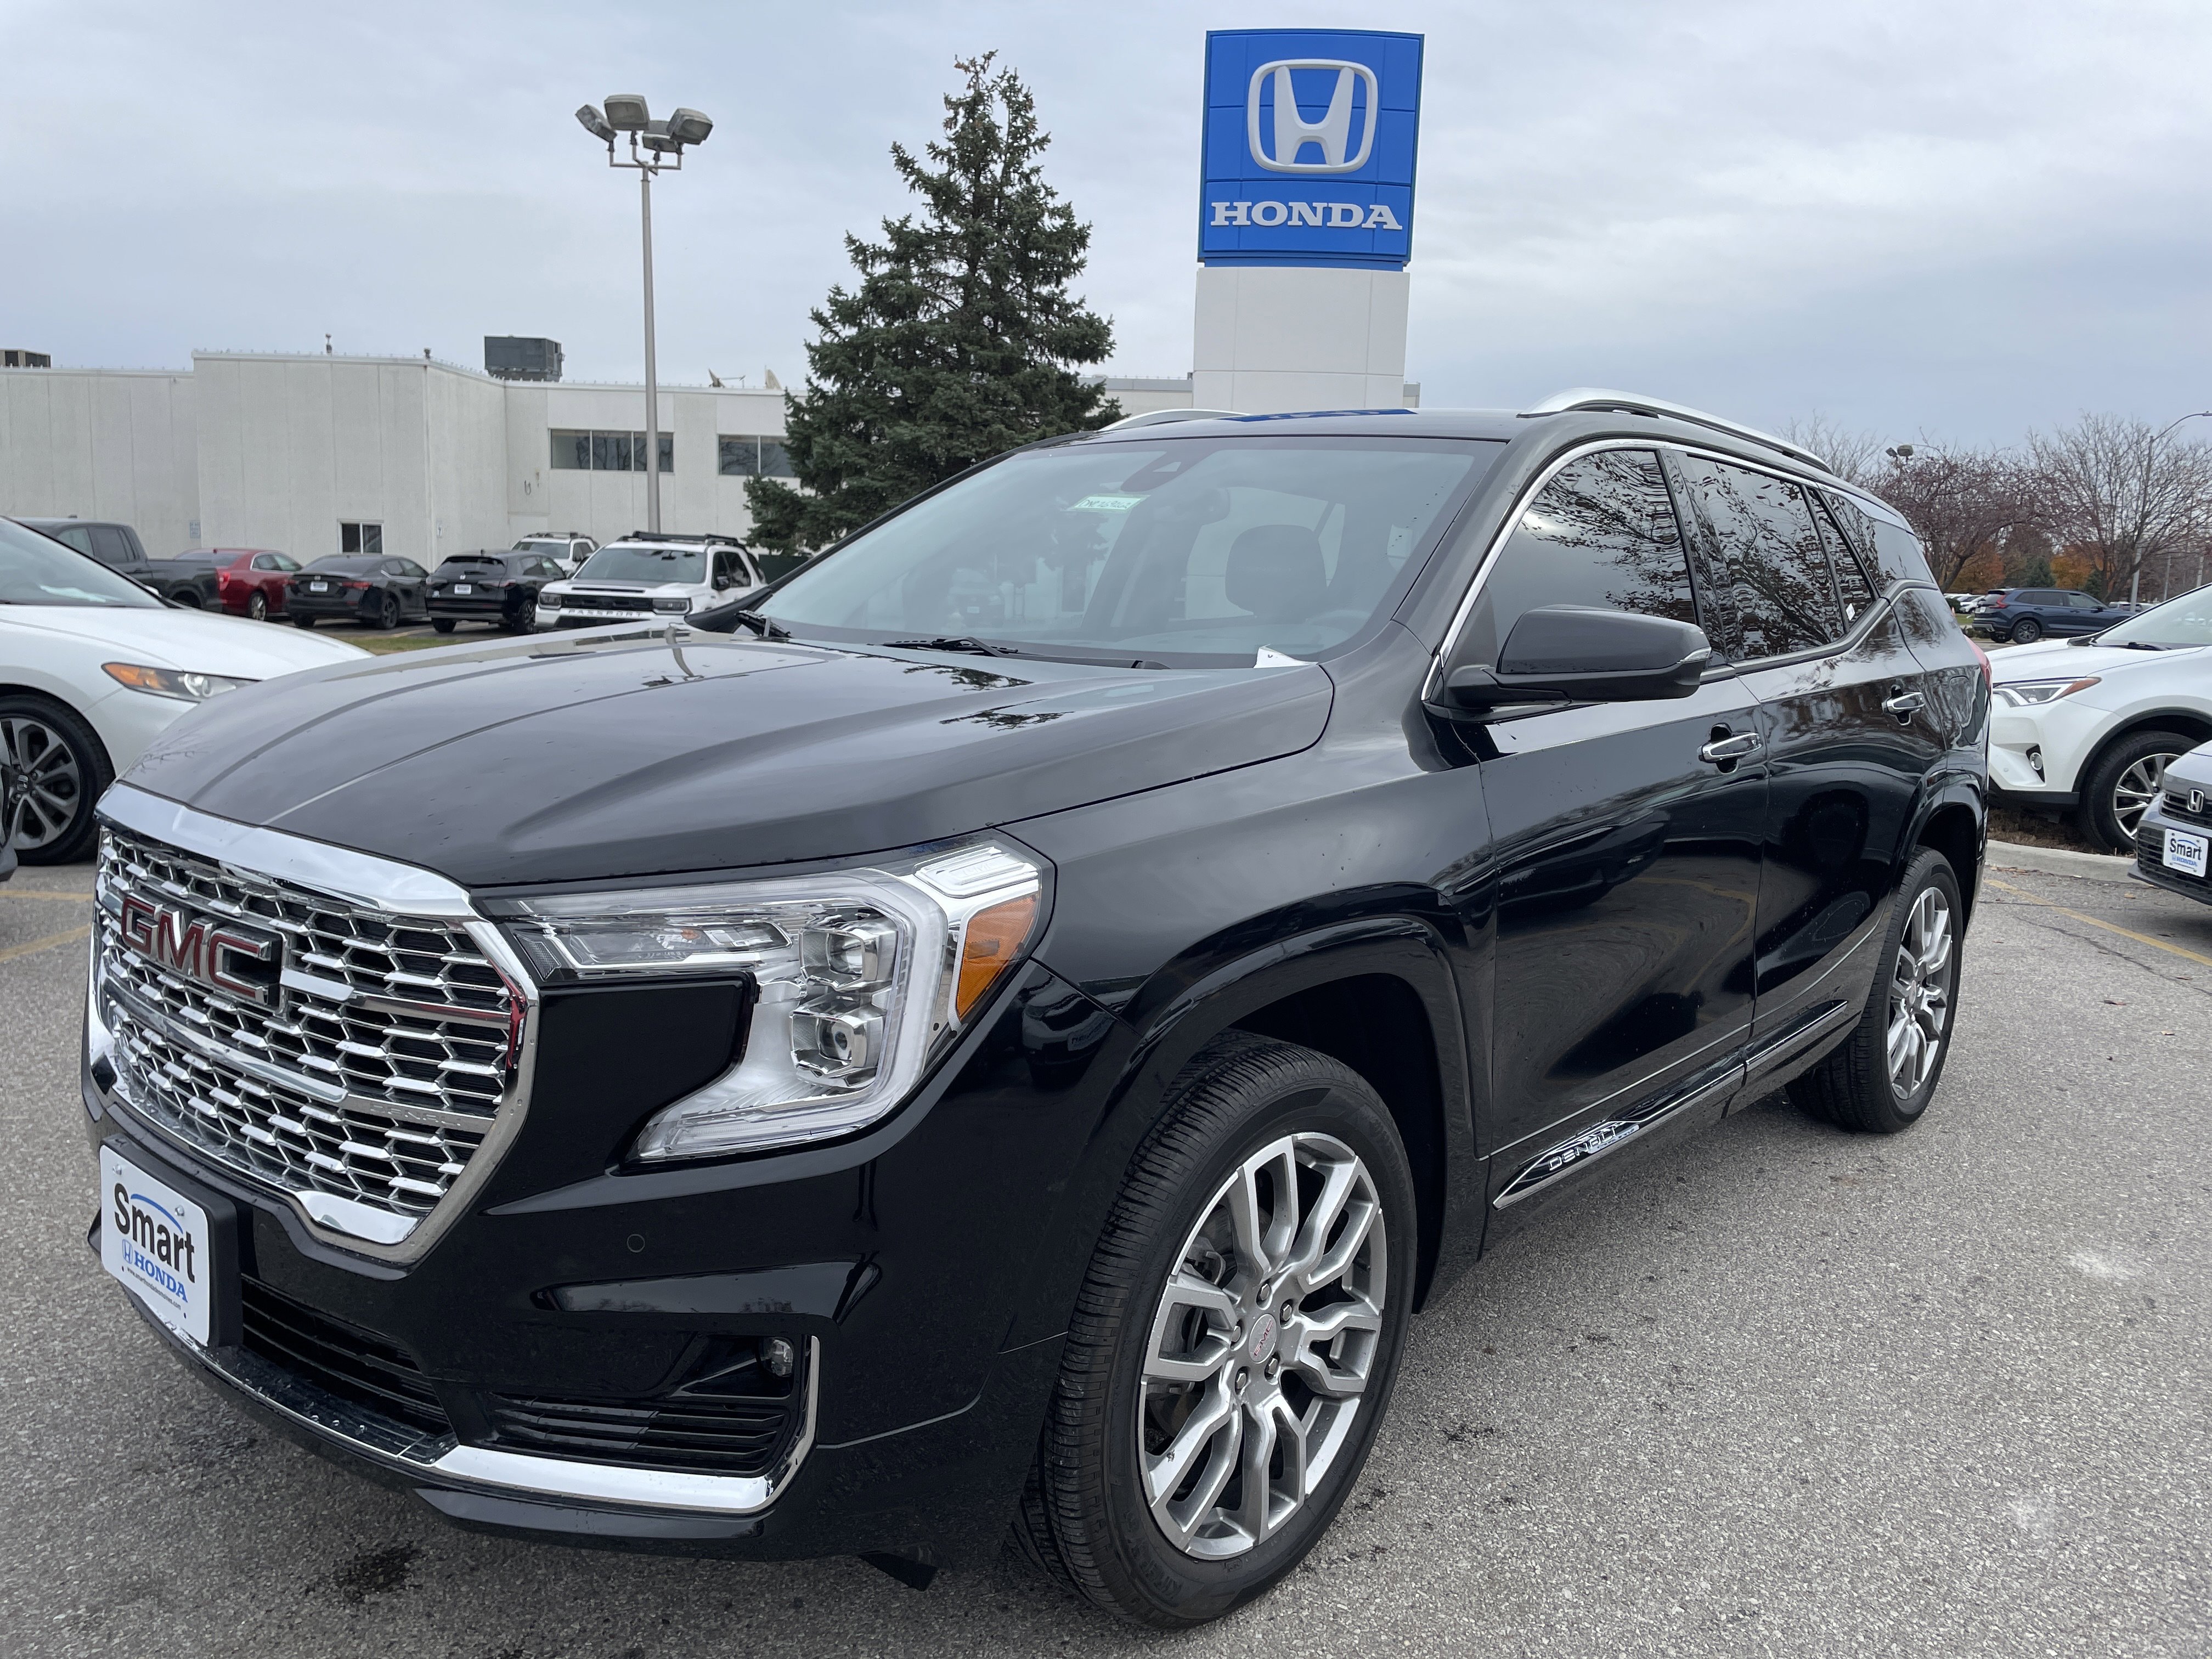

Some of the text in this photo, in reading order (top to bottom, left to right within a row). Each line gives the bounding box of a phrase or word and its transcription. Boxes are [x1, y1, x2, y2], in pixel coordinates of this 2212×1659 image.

[1210, 201, 1403, 230] HONDA
[568, 608, 643, 618] PASSPORT
[2170, 838, 2202, 861] Smart
[2176, 856, 2198, 867] HONDA
[121, 894, 270, 1005] GMC
[1548, 1125, 1616, 1171] DENALI
[114, 1183, 195, 1284] Smart
[134, 1250, 188, 1303] HONDA
[1254, 1318, 1274, 1357] GMC
